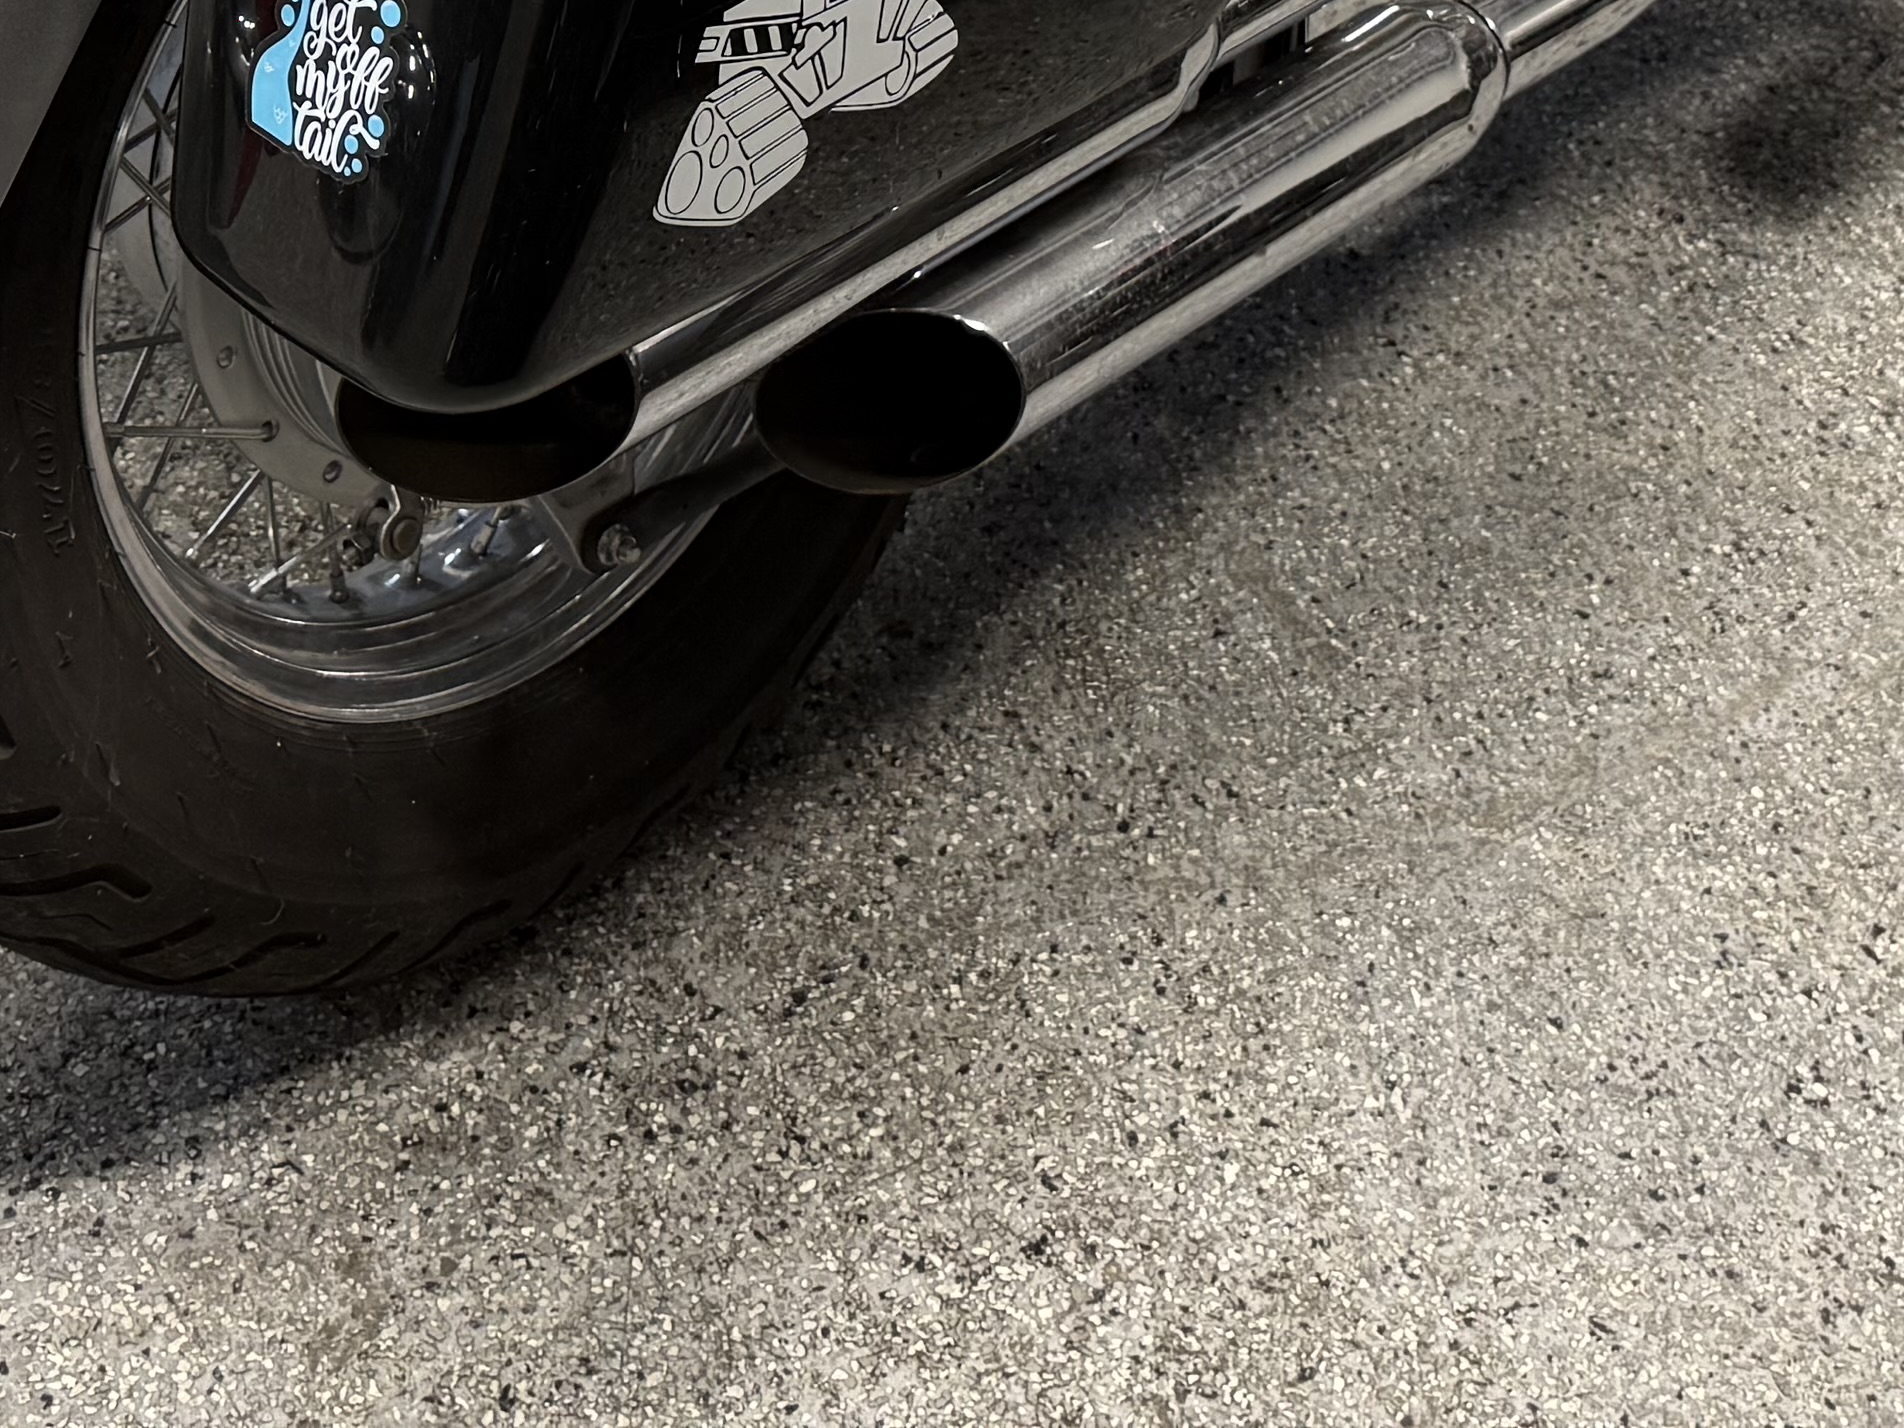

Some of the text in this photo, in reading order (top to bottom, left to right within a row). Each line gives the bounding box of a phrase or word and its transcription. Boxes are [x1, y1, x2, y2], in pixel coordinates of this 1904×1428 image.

[296, 56, 351, 119] my
[334, 42, 394, 116] off
[293, 100, 381, 174] tail
